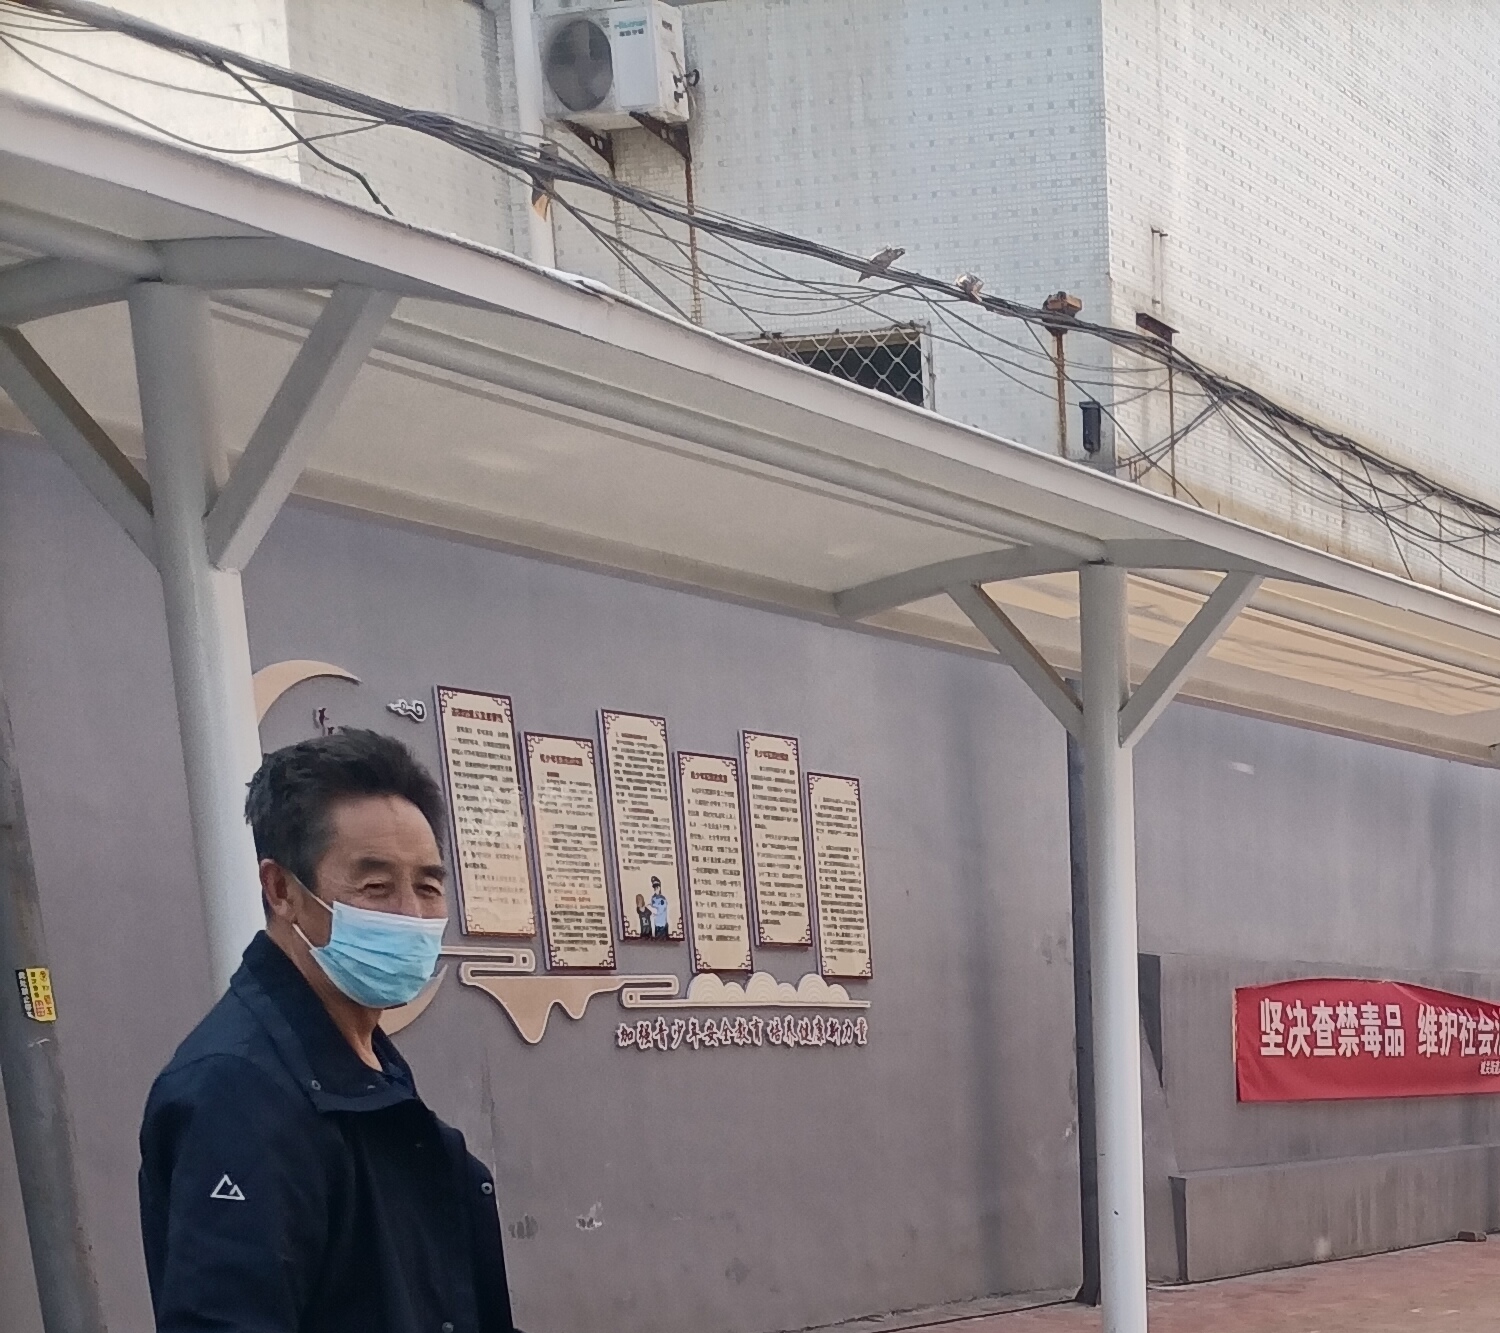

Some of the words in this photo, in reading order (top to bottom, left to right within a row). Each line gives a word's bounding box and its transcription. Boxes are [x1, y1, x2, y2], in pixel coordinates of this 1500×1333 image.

[617, 1015, 763, 1050] 加强青少年安全教育
[1260, 998, 1405, 1058] 坚决查禁毒品
